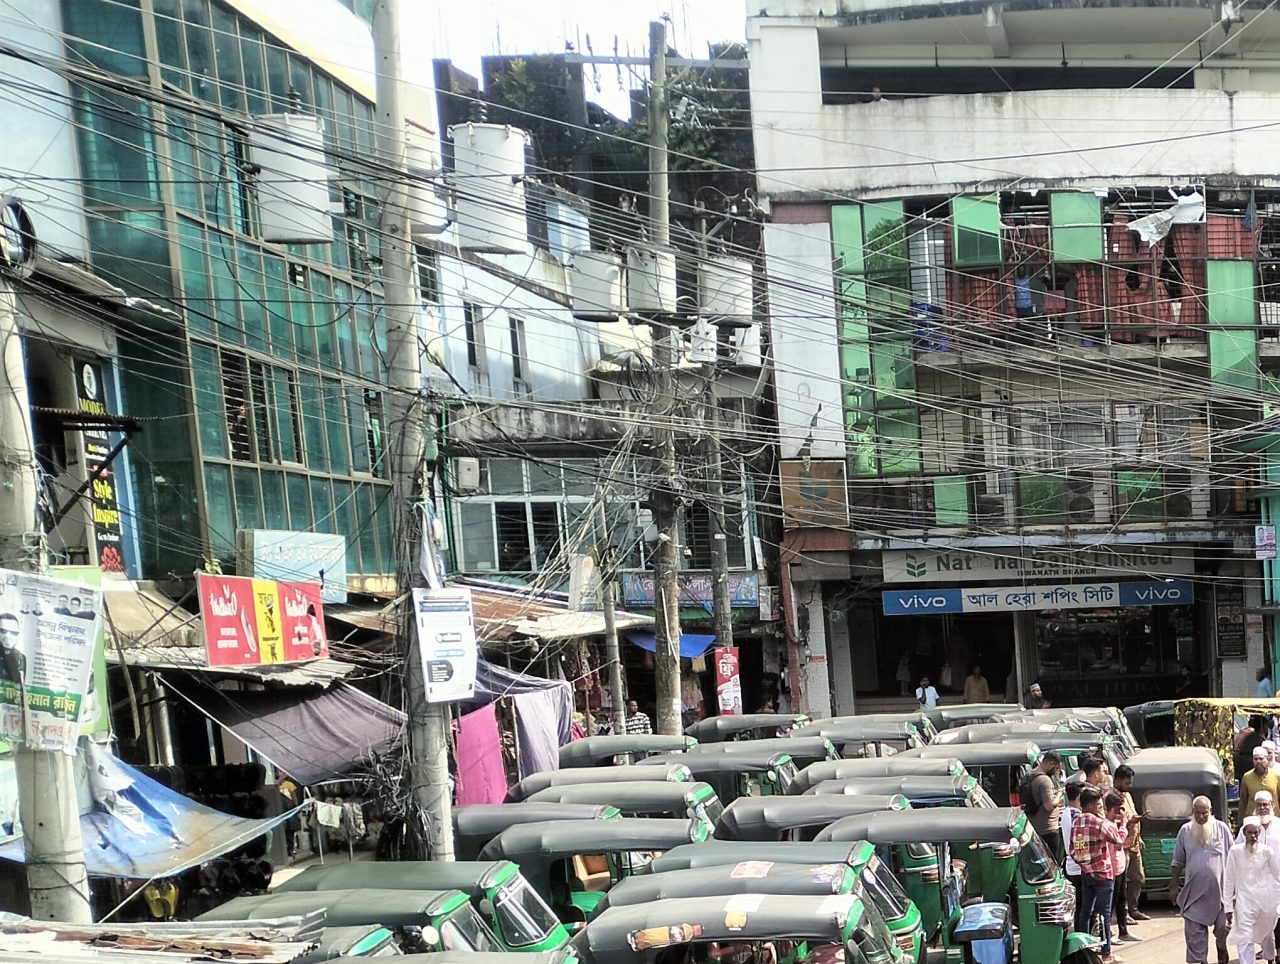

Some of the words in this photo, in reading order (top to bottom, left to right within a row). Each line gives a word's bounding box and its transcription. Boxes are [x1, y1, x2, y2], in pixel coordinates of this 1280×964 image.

[967, 593, 998, 607] আল
[1005, 592, 1037, 606] হেরা
[1042, 587, 1080, 605] শপিং
[1084, 585, 1115, 603] সিটি
[1135, 586, 1181, 600] vivo
[899, 594, 947, 609] vivo
